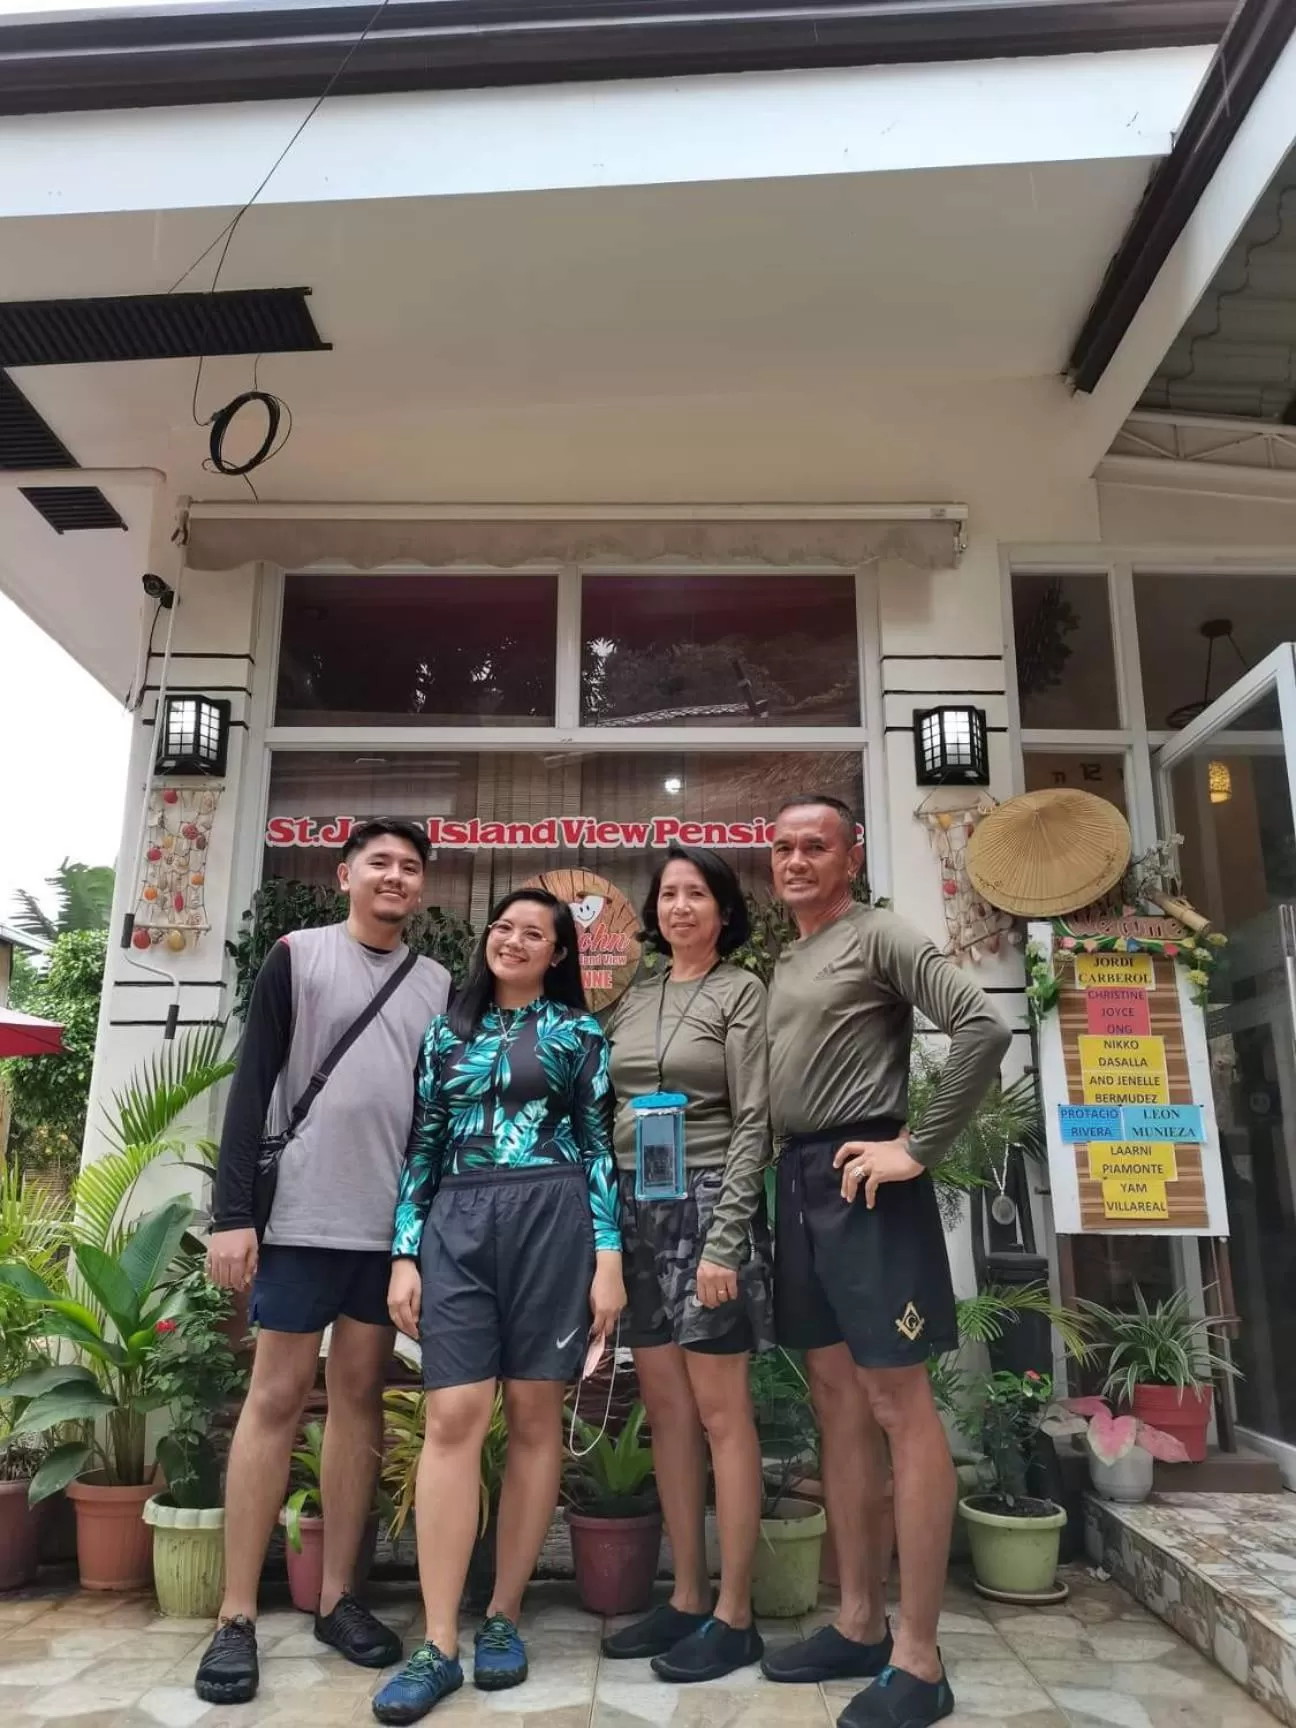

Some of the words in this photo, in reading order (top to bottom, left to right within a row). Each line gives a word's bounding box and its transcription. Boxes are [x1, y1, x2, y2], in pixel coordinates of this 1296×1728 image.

[1079, 763, 1103, 781] 12
[428, 818, 556, 846] Island
[559, 818, 650, 845] View
[580, 922, 628, 952] ohn
[1094, 956, 1134, 967] JORDI
[1088, 990, 1144, 1000] CHRISTINE
[1102, 1007, 1135, 1017] JOYCE
[1106, 1024, 1133, 1034] ONG
[1103, 1040, 1139, 1050] NIKKO
[1098, 1057, 1148, 1067] DASALLA
[1089, 1076, 1114, 1086] AND
[1116, 1076, 1160, 1086] JENELLE
[1095, 1094, 1158, 1104] BERMUDEZ
[1061, 1109, 1119, 1119] PROTACIO
[1143, 1109, 1181, 1120] LEON
[1071, 1127, 1113, 1137] RIVERA
[1132, 1127, 1196, 1138] MUNIEZA
[1110, 1146, 1152, 1156] LAARNI
[1102, 1163, 1164, 1174] PIAMONTE
[1120, 1183, 1148, 1193] YAM
[1106, 1201, 1167, 1212] VILLAREAL
